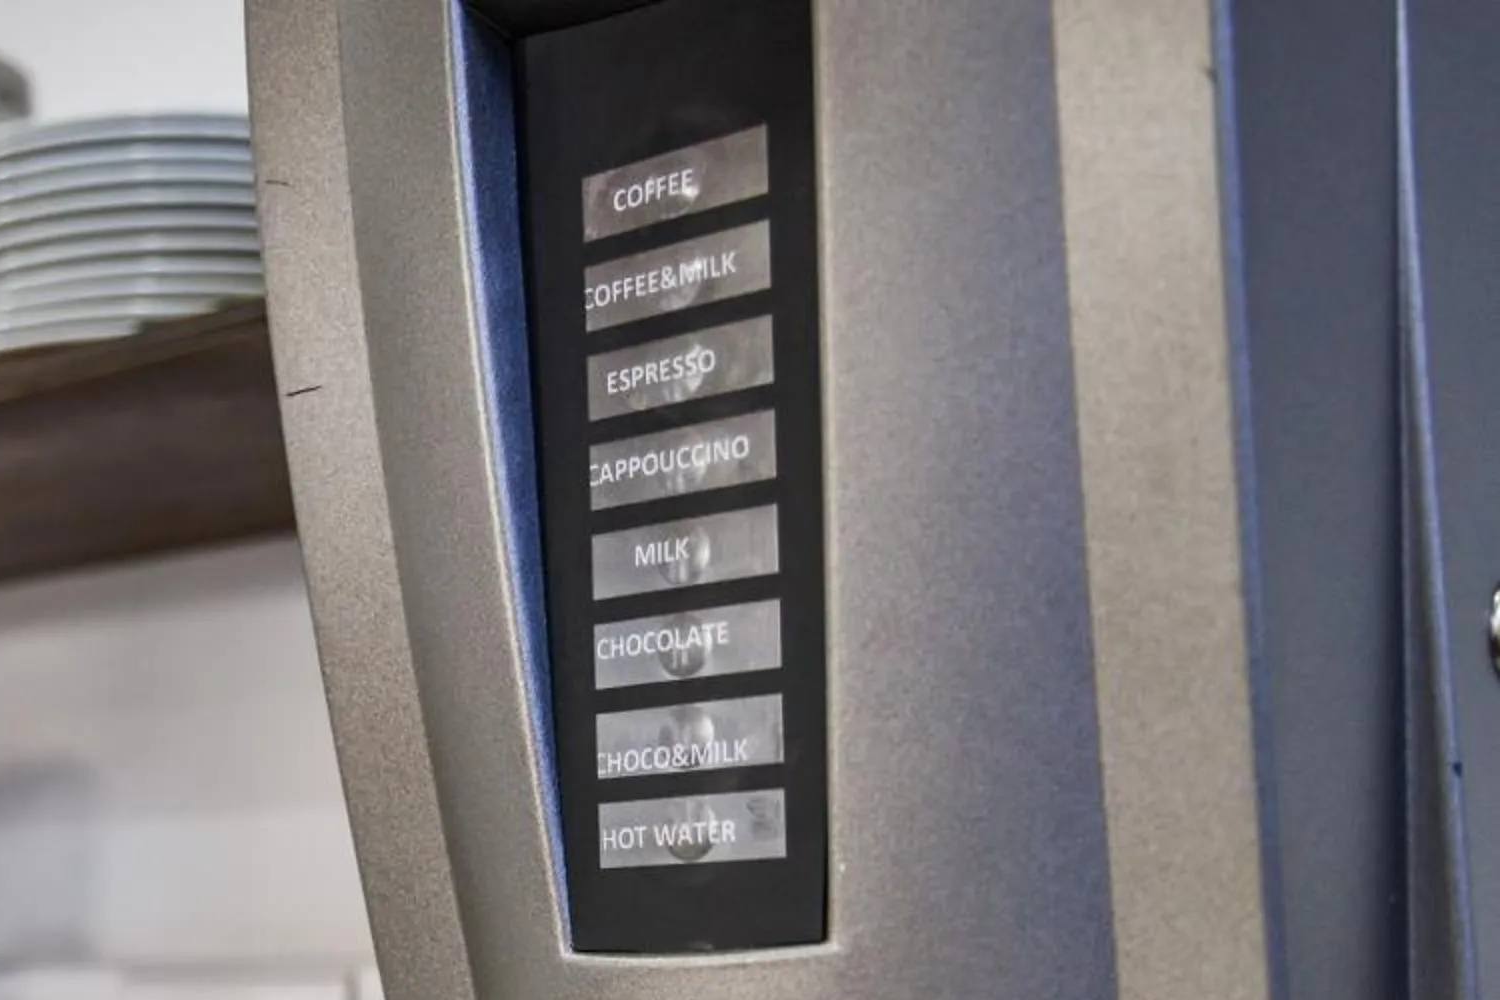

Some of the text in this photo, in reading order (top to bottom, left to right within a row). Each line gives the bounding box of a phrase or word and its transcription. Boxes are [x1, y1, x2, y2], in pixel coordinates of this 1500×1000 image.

[612, 168, 695, 212] COFFEE
[606, 349, 716, 394] ESPRESSO
[589, 434, 749, 487] CAPPOUCCINO
[634, 535, 691, 568] MILK
[596, 621, 730, 660] CHOCOLATE
[602, 819, 737, 852] HOT WATER
